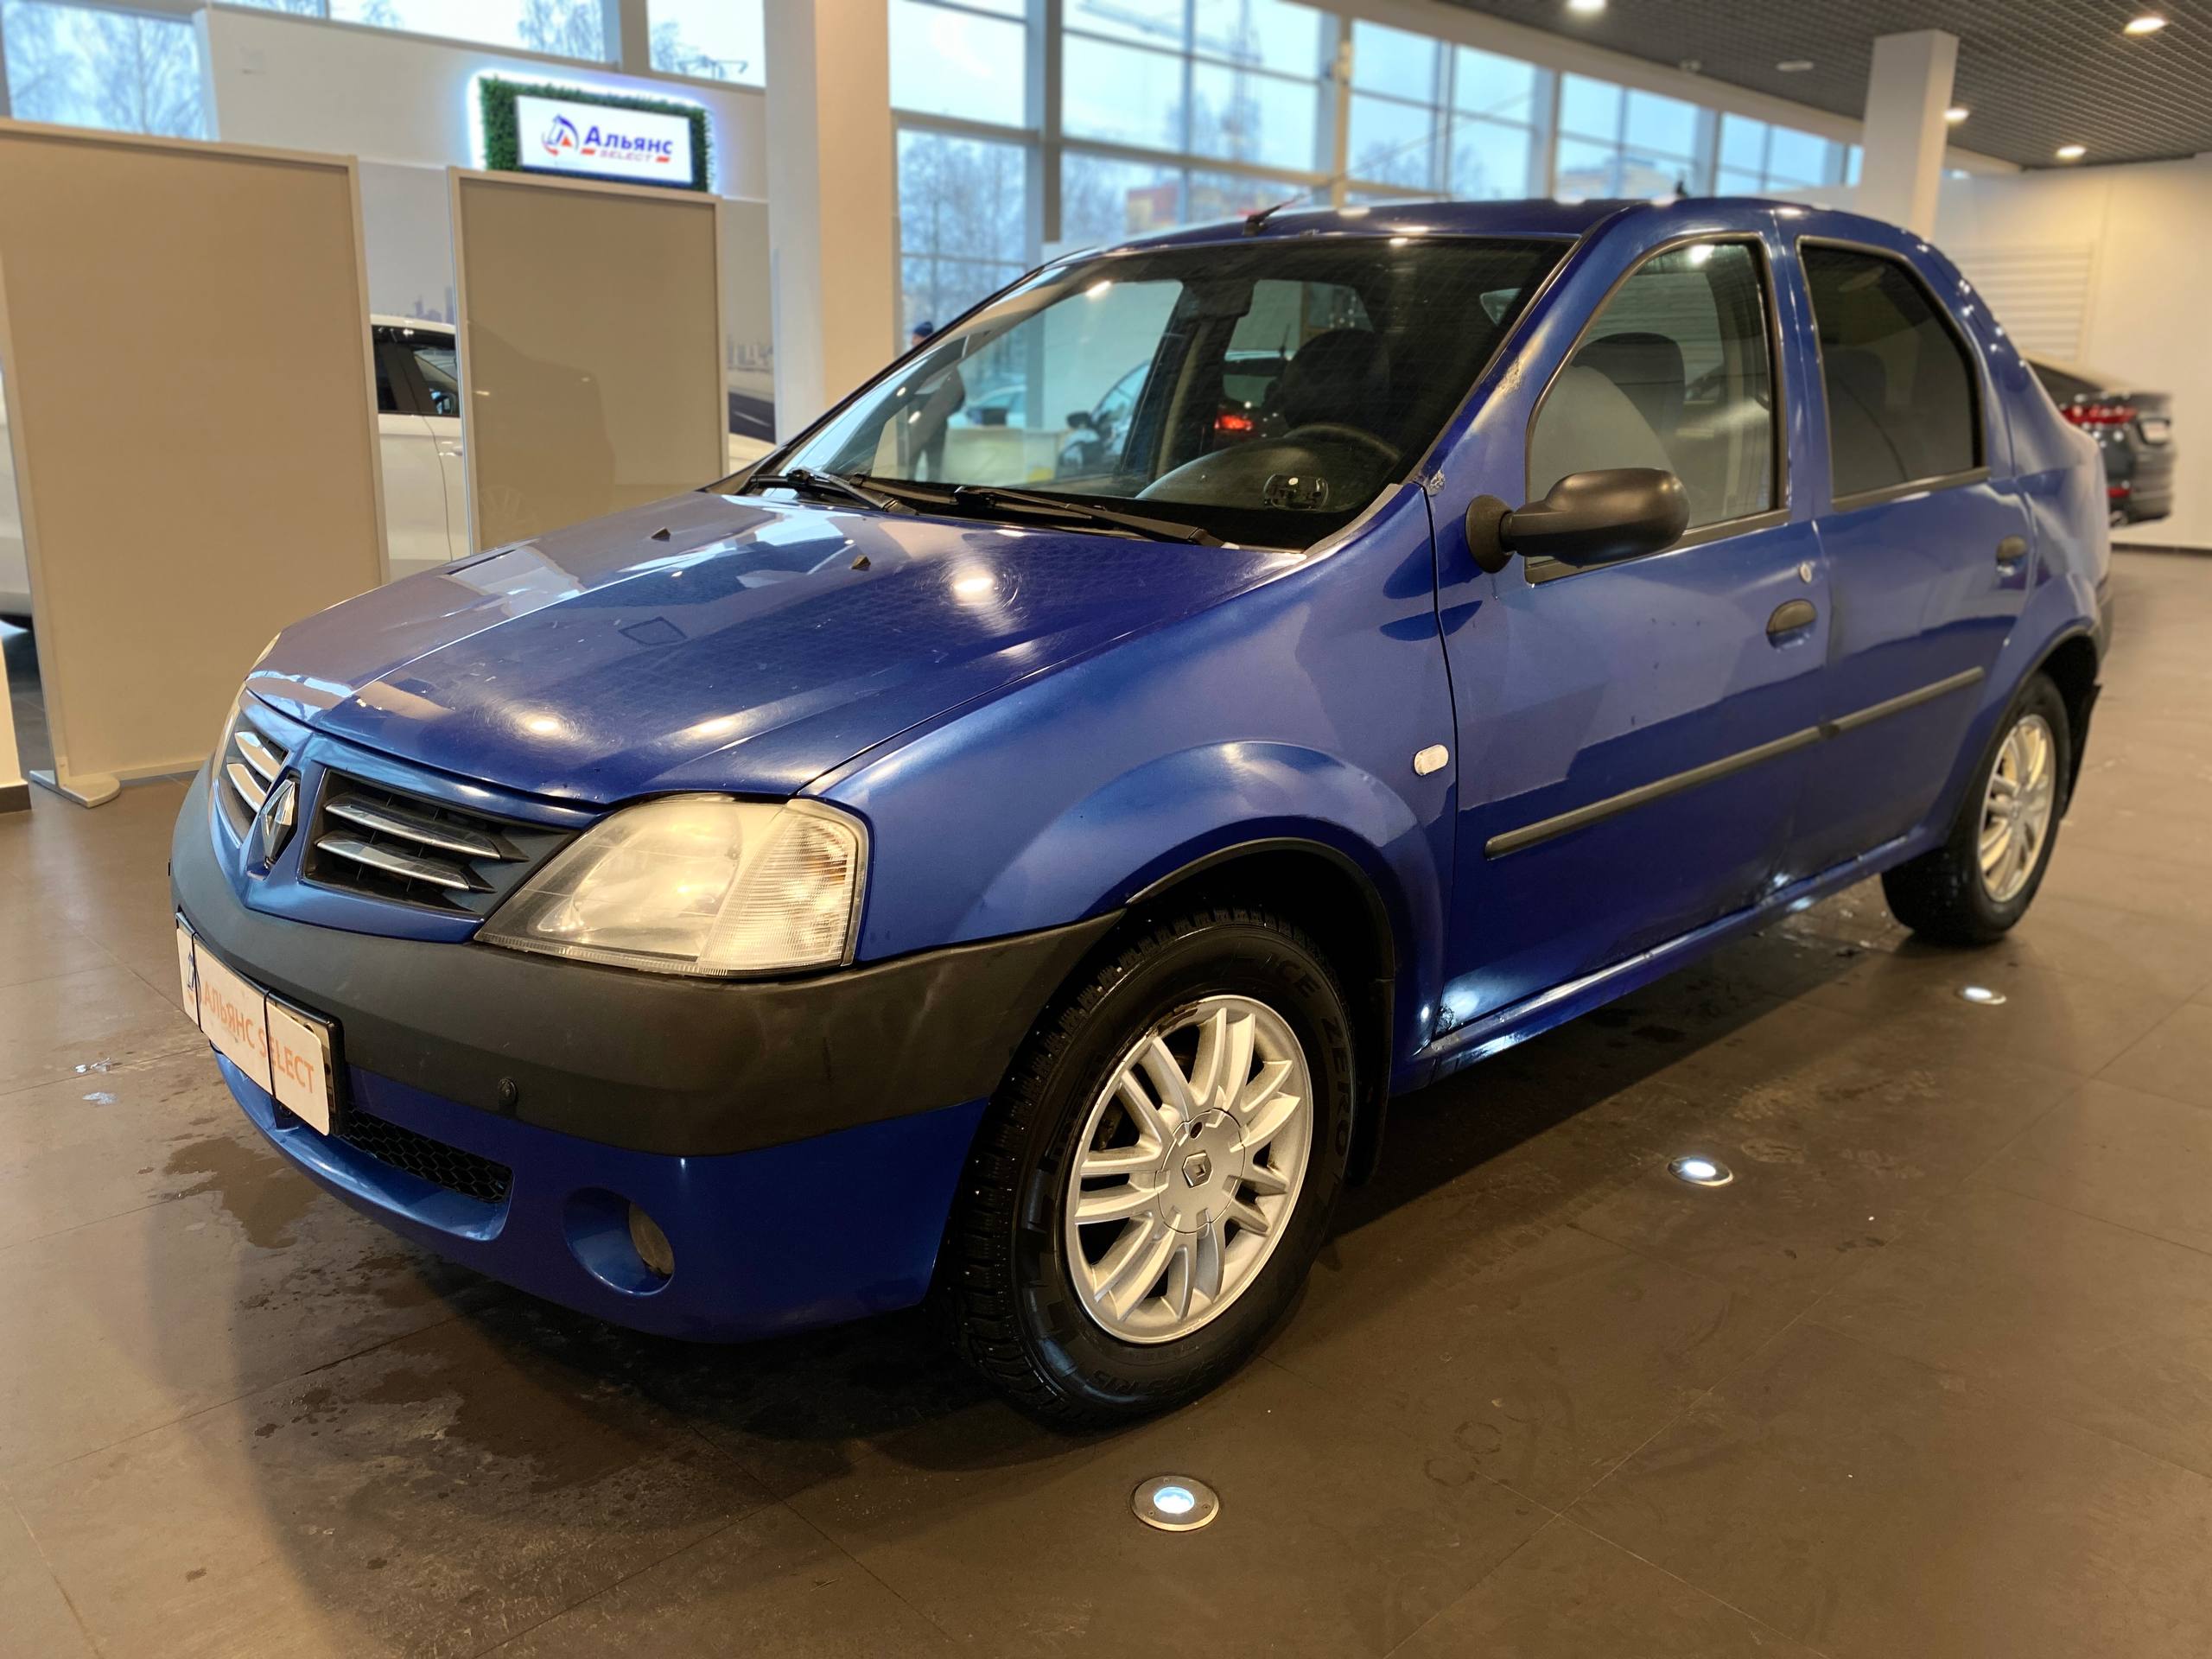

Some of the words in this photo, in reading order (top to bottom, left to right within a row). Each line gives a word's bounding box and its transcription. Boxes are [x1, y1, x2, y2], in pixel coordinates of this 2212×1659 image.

[585, 125, 673, 154] Альянс
[599, 150, 653, 162] SELECT
[203, 982, 255, 1049] АЛЬЯНС
[257, 1028, 314, 1094] SELECT
